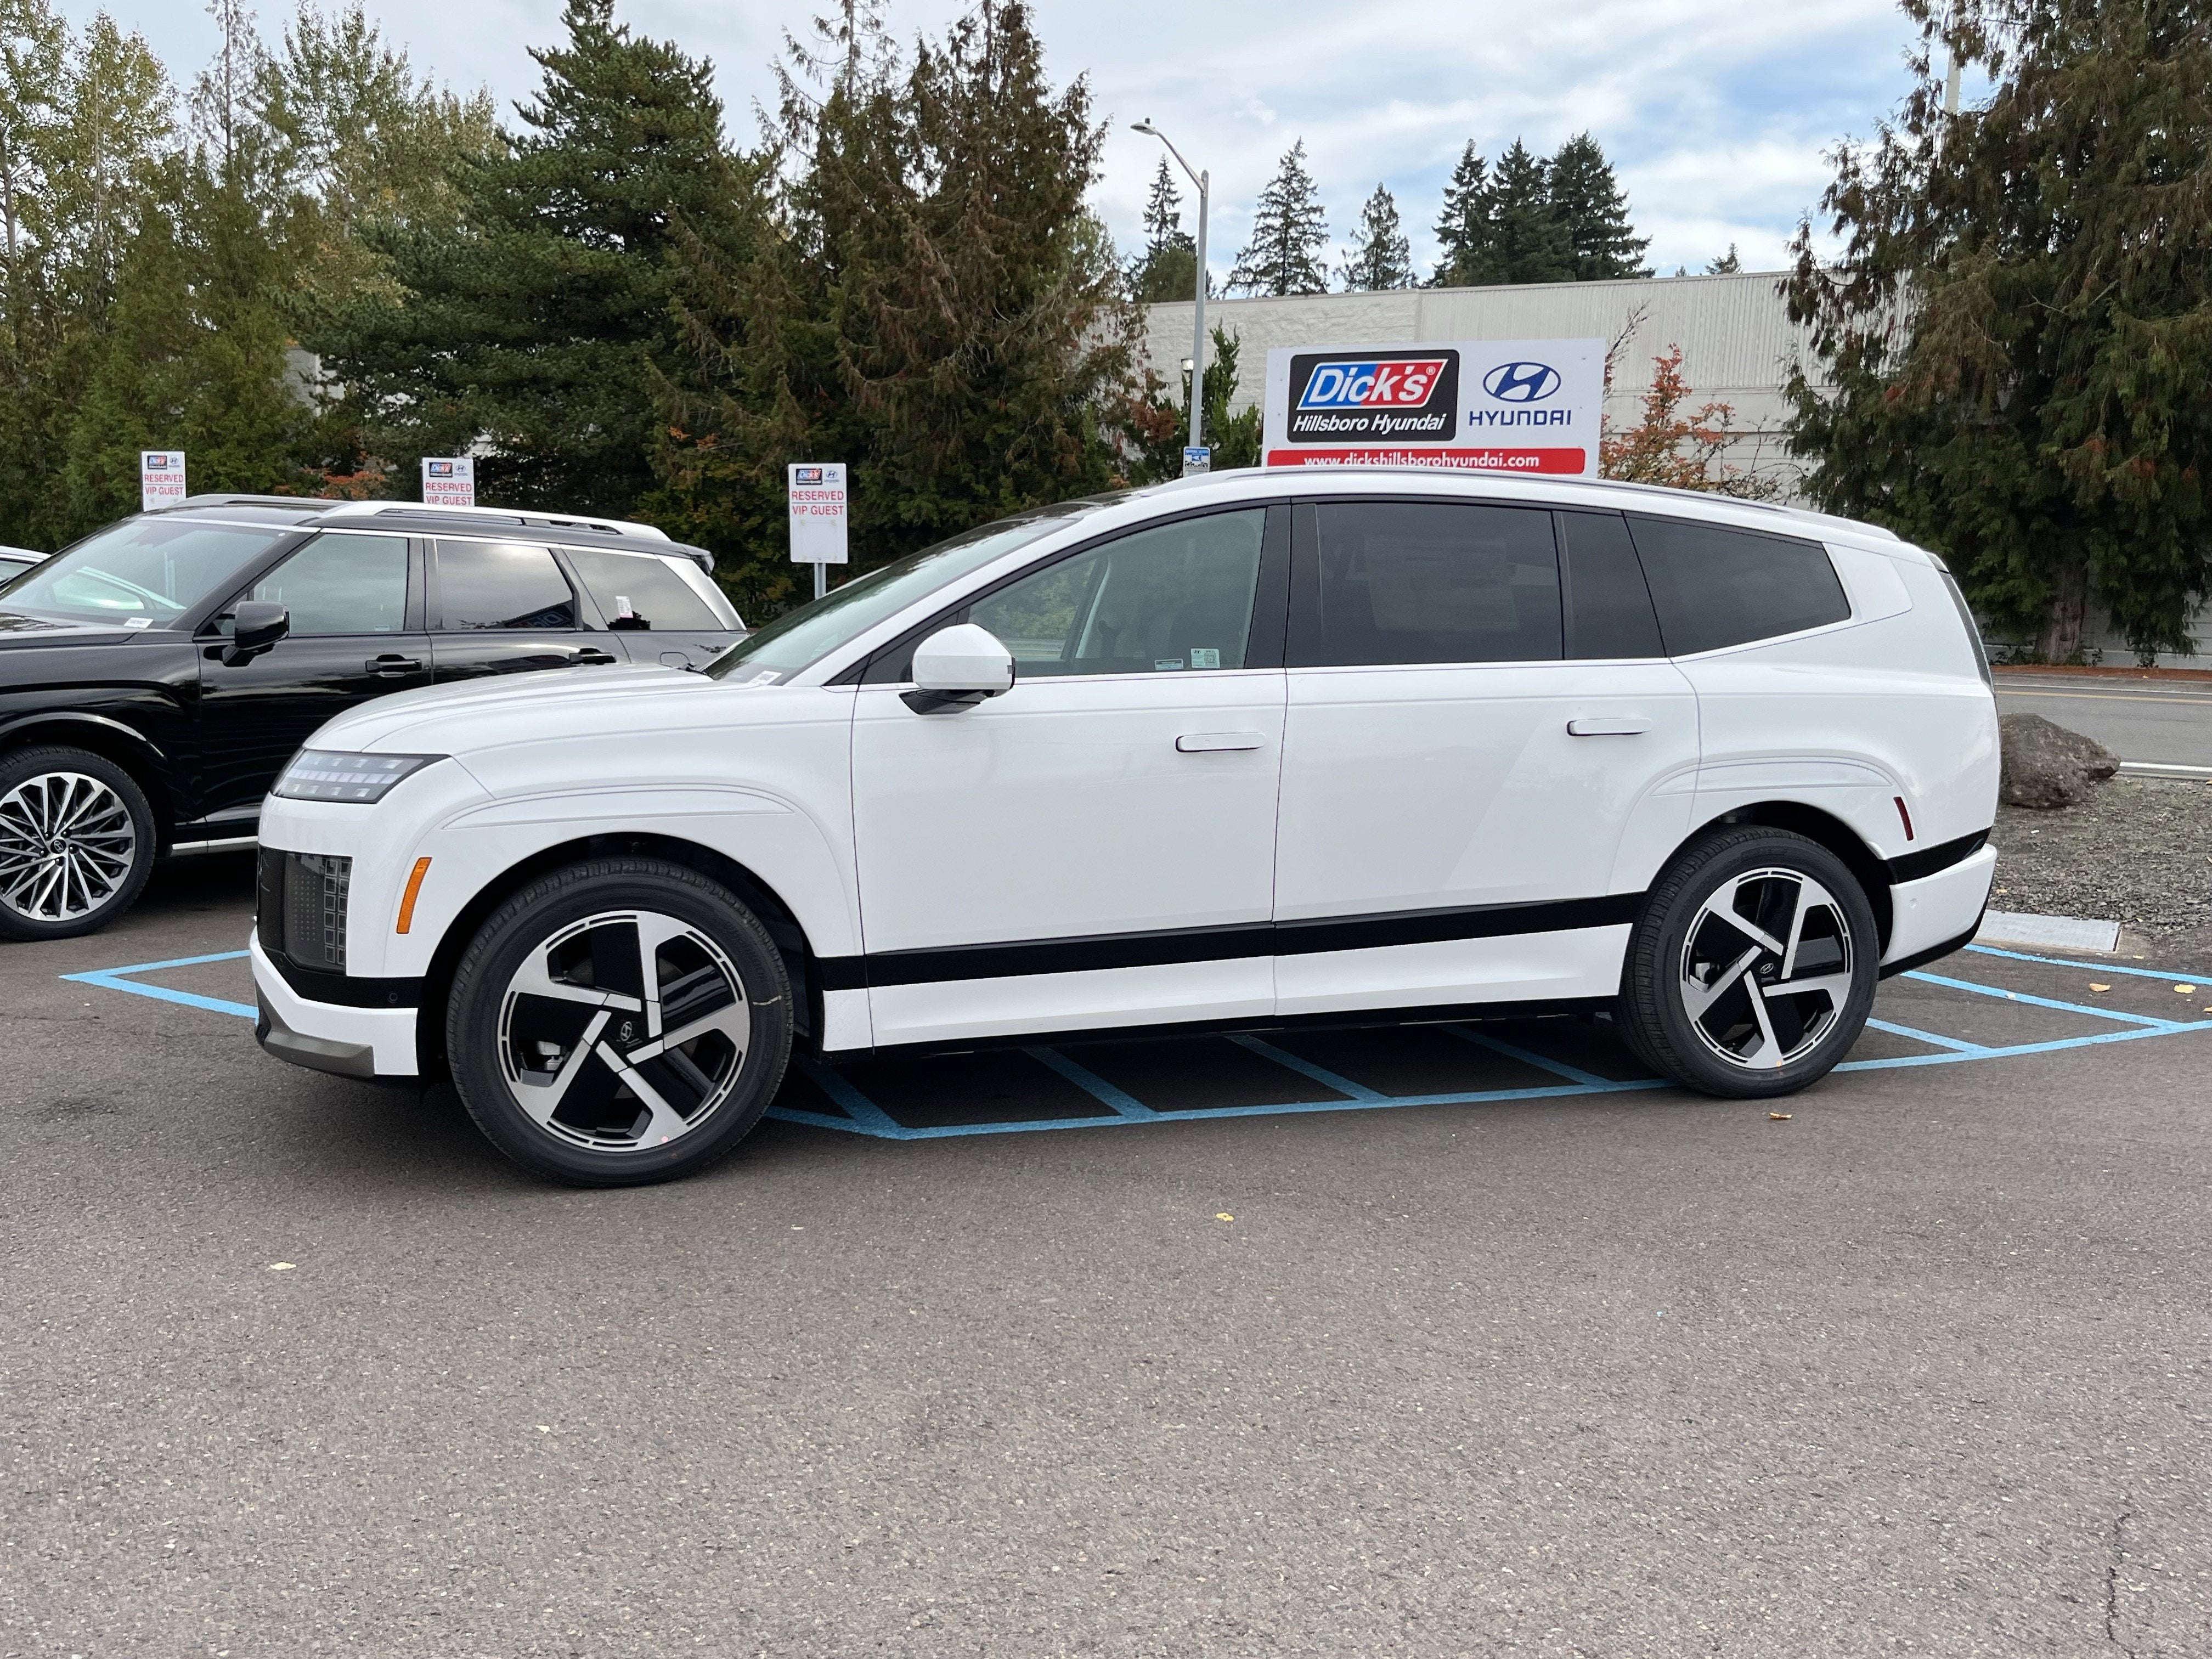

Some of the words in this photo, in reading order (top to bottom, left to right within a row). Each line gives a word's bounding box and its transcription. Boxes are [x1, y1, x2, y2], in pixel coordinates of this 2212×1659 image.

[1308, 365, 1428, 403] Dick's
[1469, 410, 1571, 426] HYUNDAI
[1293, 415, 1369, 432] Hillsboro
[1371, 413, 1447, 435] Hyundai
[144, 474, 184, 482] RESERVED
[145, 487, 157, 495] VIP
[159, 487, 184, 495] GUEST
[425, 482, 472, 492] RESERVED
[426, 495, 440, 504] VIP
[443, 496, 472, 505] GUEST
[791, 490, 844, 500] RESERVED
[792, 505, 808, 515] VIP
[811, 506, 844, 515] GUEST
